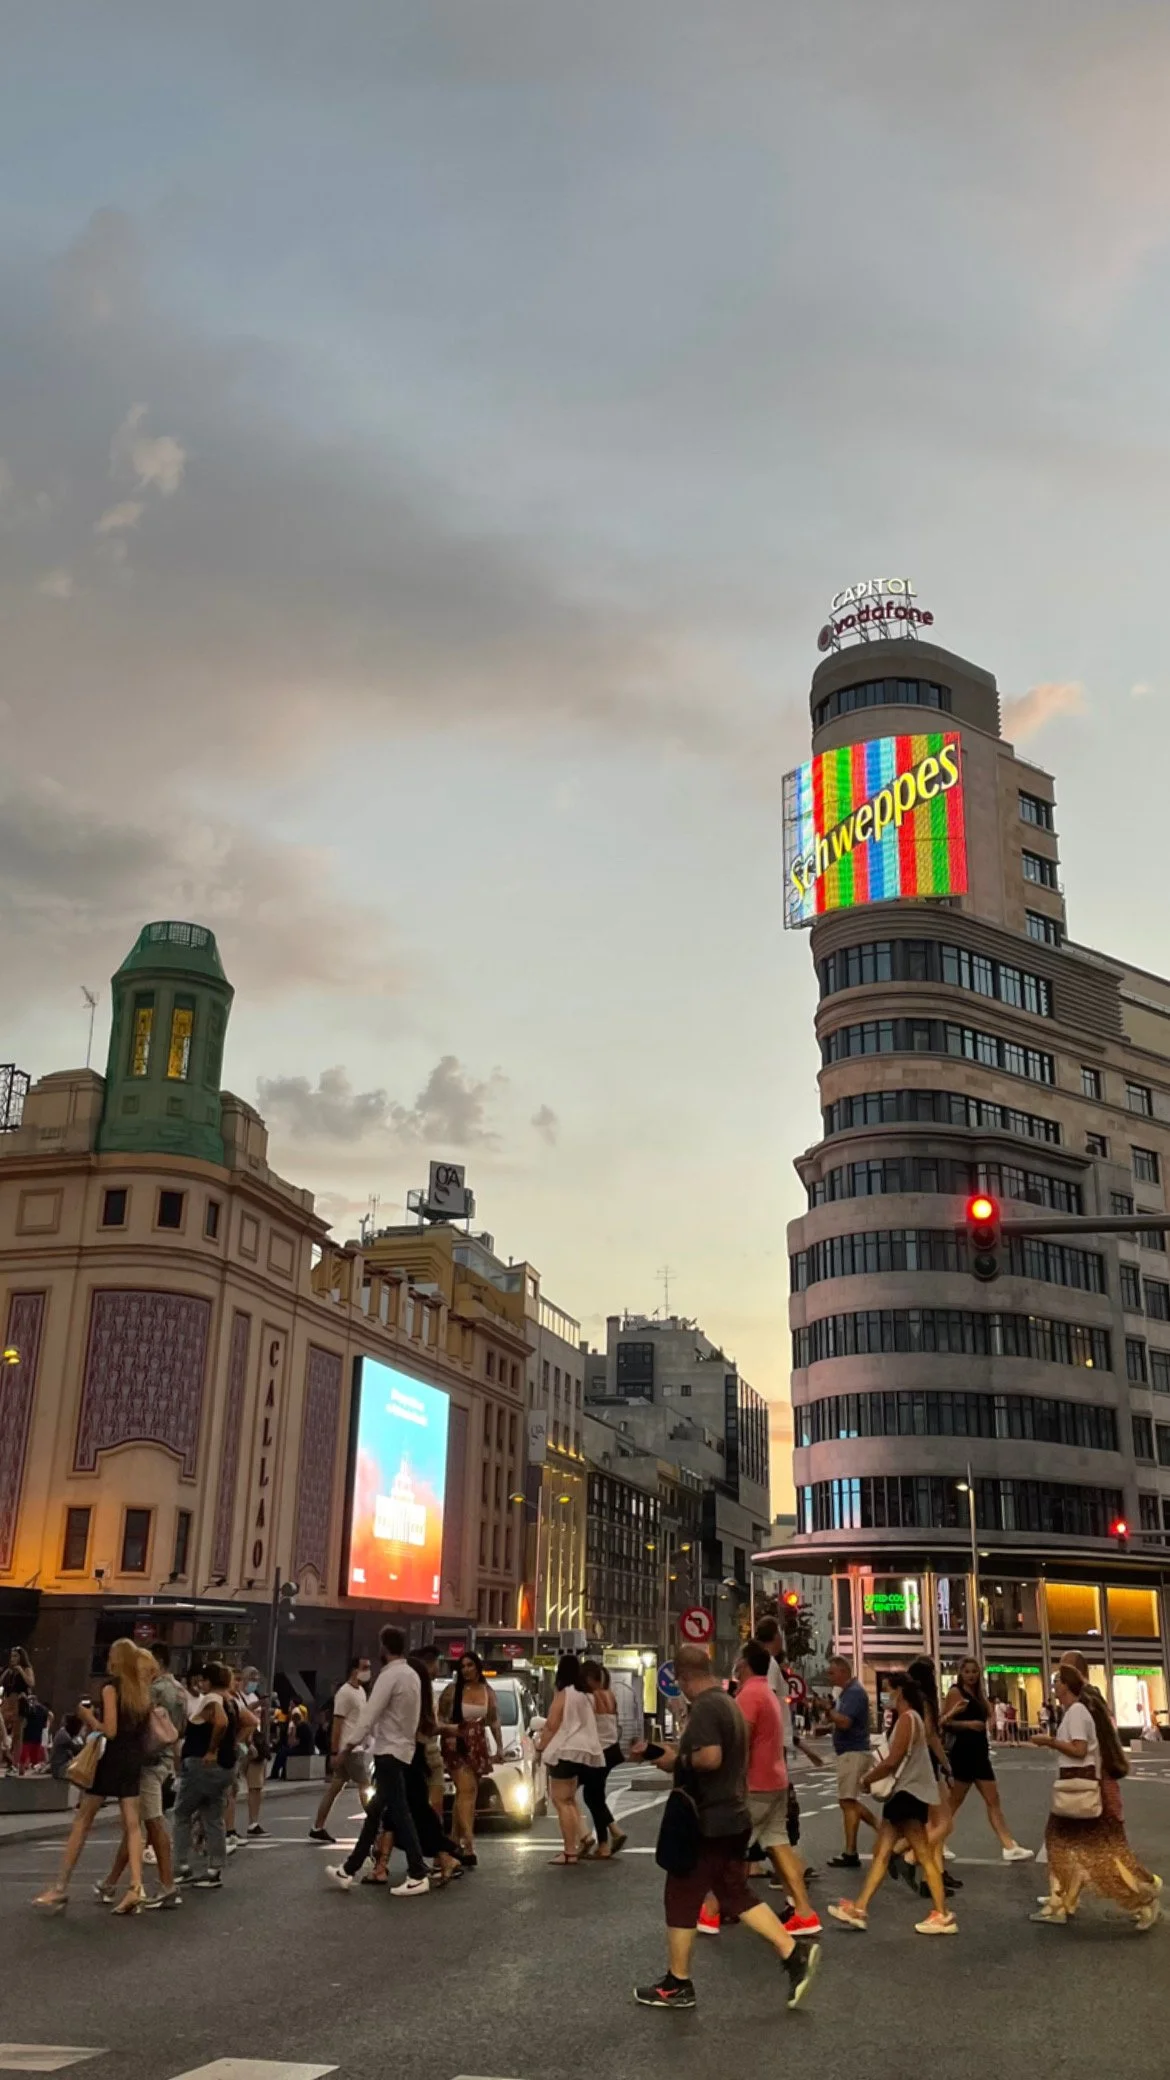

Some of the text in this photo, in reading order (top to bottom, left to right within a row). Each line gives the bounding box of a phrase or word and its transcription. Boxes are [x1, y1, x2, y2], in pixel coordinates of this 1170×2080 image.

[831, 578, 917, 611] CAPITOL
[834, 601, 934, 634] vodafone
[788, 744, 959, 912] Schweppes
[253, 1341, 279, 1568] CALLAO
